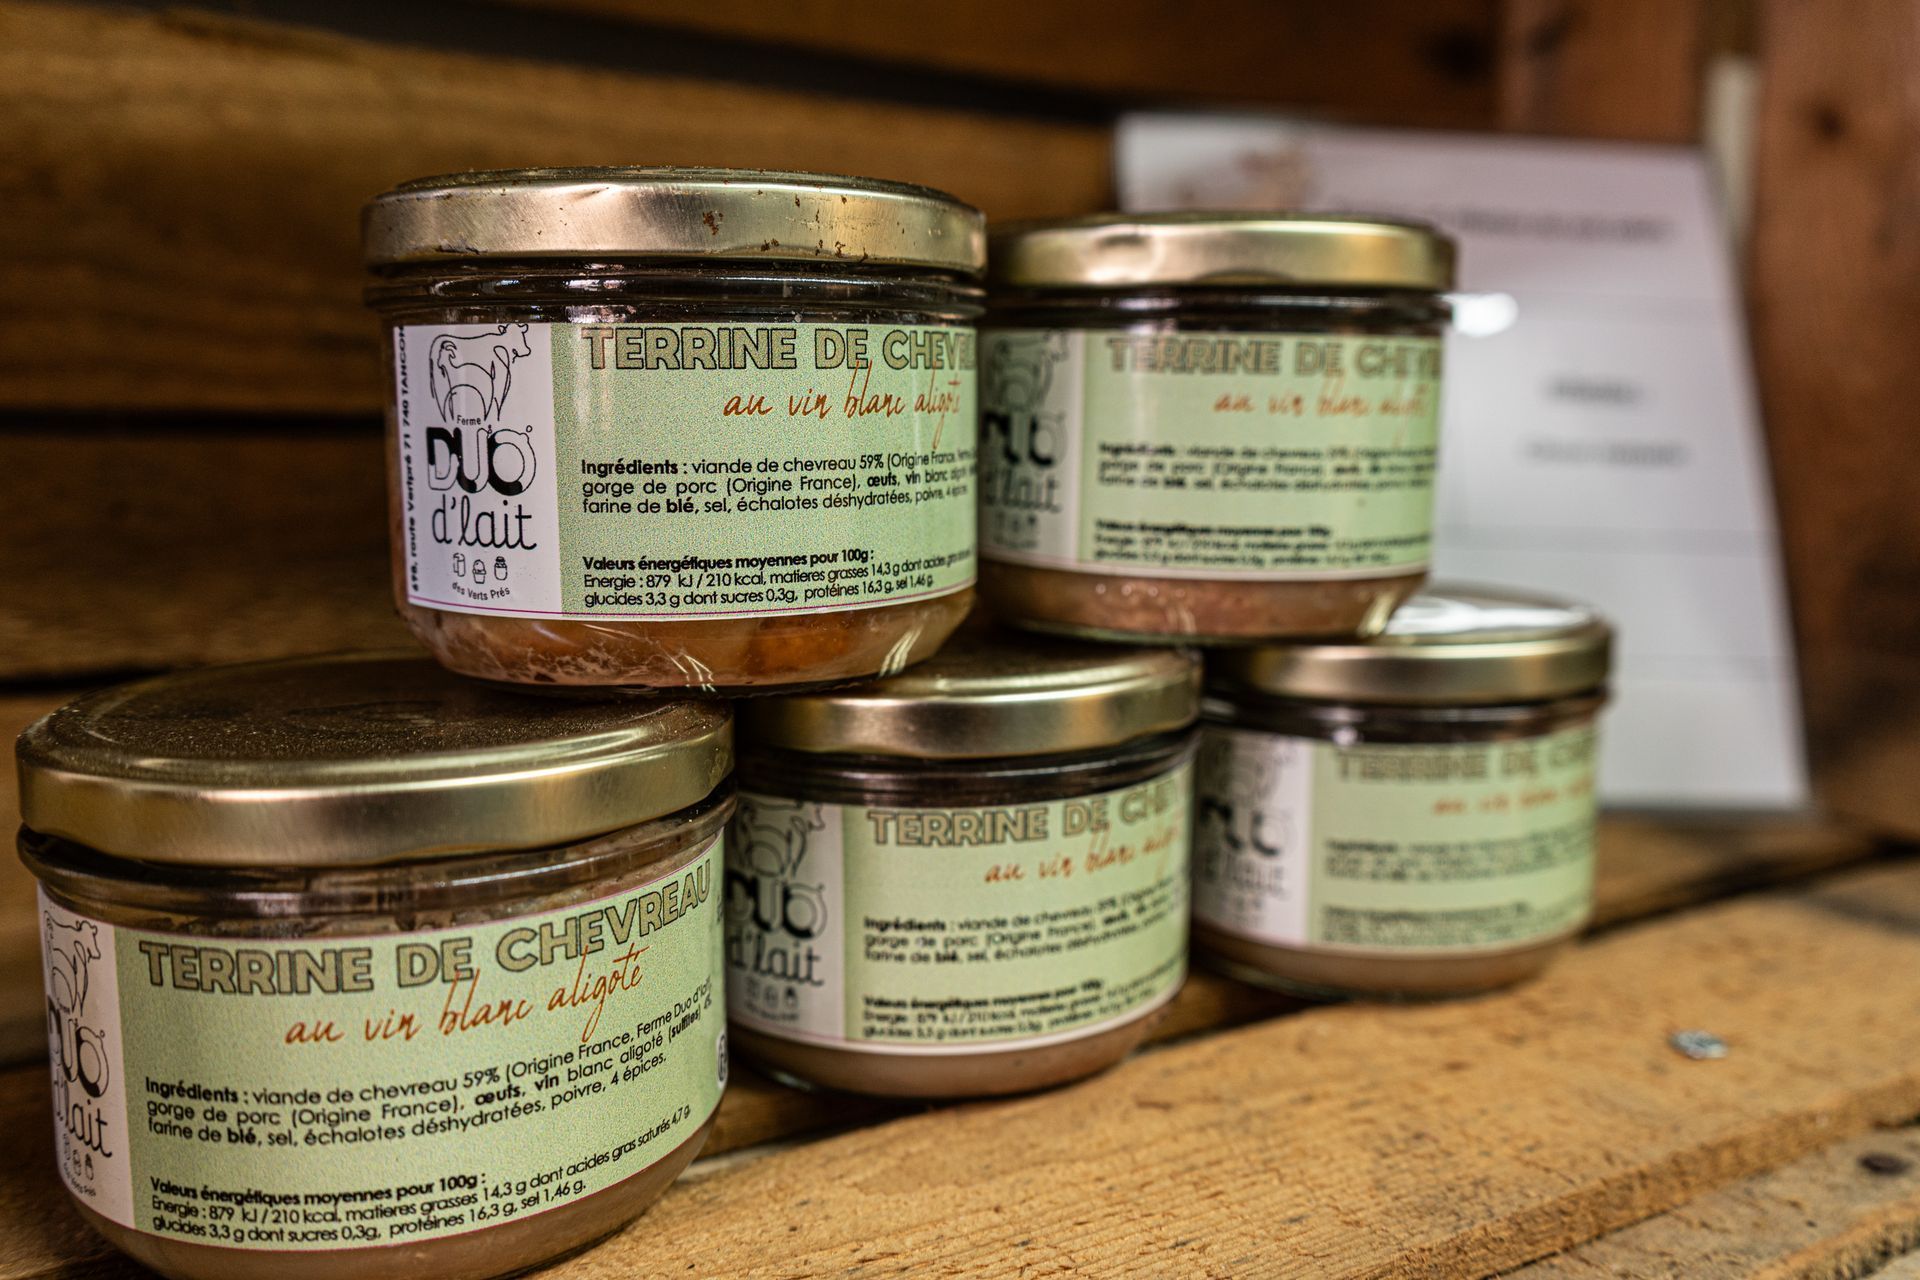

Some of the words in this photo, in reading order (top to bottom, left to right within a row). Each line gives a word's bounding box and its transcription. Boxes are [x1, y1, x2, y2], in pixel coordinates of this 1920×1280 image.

[580, 326, 797, 370] TERRINE
[815, 328, 869, 370] DE
[1106, 338, 1281, 376] TERRINE
[1296, 341, 1345, 378] DE
[722, 394, 772, 416] au
[788, 388, 832, 419] vin
[843, 358, 906, 419] blanc
[456, 414, 482, 426] Ferme
[426, 425, 536, 496] DUO
[581, 458, 678, 477] Ingrédients
[692, 458, 752, 474] viande
[756, 457, 779, 473] de
[783, 457, 856, 472] chevreau
[859, 454, 884, 469] 59%
[887, 453, 929, 470] (Origine
[582, 481, 634, 497] gorge
[643, 480, 667, 494] de
[676, 481, 717, 497] porc
[727, 477, 792, 497] (Origine
[800, 474, 861, 492] France),
[867, 472, 900, 488] œufs,
[905, 470, 921, 485] vin
[583, 499, 631, 514] farine
[637, 498, 660, 513] de
[666, 496, 699, 514] blé,
[704, 498, 731, 514] sel,
[737, 495, 818, 512] échalotes
[823, 491, 913, 510] déshydratées,
[432, 494, 537, 550] d'lait
[582, 556, 635, 571] Valeurs
[638, 555, 732, 573] énergétiques
[735, 554, 807, 571] moyennes
[810, 552, 839, 568] pour
[584, 574, 636, 591] Energie
[646, 574, 671, 588] 879
[678, 573, 693, 588] kJ
[706, 573, 731, 587] 210
[734, 572, 766, 586] kcal,
[770, 568, 825, 585] matieres
[827, 567, 868, 584] grasses
[871, 563, 891, 576] 14,3
[892, 563, 900, 572] g
[901, 558, 922, 573] dont
[467, 588, 488, 601] Verts
[490, 586, 511, 600] Prés
[585, 592, 642, 608] glucides
[645, 592, 667, 606] 3,3
[669, 594, 680, 607] g
[683, 591, 718, 605] dont
[720, 591, 764, 604] sucres
[804, 583, 859, 602] protéines
[862, 581, 883, 594] 16,3
[896, 576, 908, 589] sel
[867, 806, 1049, 847] TERRINE
[1062, 799, 1111, 838] DE
[984, 863, 1025, 883] au
[1038, 853, 1075, 879] vin
[139, 940, 374, 995] TERRINE
[396, 937, 474, 988] DE
[496, 859, 711, 973] CHEVREAU
[285, 1020, 345, 1044] au
[364, 1009, 424, 1042] vin
[438, 967, 535, 1036] blanc
[547, 943, 652, 1044] aligoté
[145, 1076, 238, 1102] Ingrédients
[253, 1088, 321, 1105] viande
[327, 1087, 354, 1103] de
[359, 1078, 457, 1102] chevreau
[462, 1067, 501, 1089] 59%
[505, 1049, 574, 1083] (Origine
[578, 1032, 635, 1059] France,
[637, 1012, 672, 1039] Ferme
[673, 996, 692, 1018] Duo
[147, 1100, 195, 1120] gorge
[203, 1106, 227, 1122] de
[237, 1109, 281, 1131] porc
[292, 1107, 371, 1128] (Origine
[382, 1095, 465, 1119] France),
[474, 1081, 527, 1106] œufs,
[534, 1073, 559, 1092] vin
[567, 1056, 613, 1083] blanc
[619, 1031, 664, 1065] aligoté
[148, 1119, 193, 1139] farine
[198, 1125, 222, 1143] de
[227, 1127, 262, 1147] blé,
[267, 1129, 298, 1147] sel,
[304, 1123, 406, 1146] échalotes
[412, 1099, 545, 1135] déshydratées,
[551, 1079, 606, 1108] poivre,
[610, 1072, 620, 1086] 4
[150, 1176, 198, 1198] Valeurs
[201, 1185, 301, 1207] énergétiques
[304, 1187, 392, 1206] moyennes
[397, 1180, 434, 1201] pour
[152, 1195, 200, 1220] Energie
[209, 1206, 235, 1221] 879
[241, 1207, 257, 1223] kJ
[272, 1208, 299, 1223] 210
[345, 1203, 417, 1222] matieres
[420, 1193, 478, 1214] grasses
[484, 1182, 513, 1200] 14,3
[516, 1180, 527, 1196] g
[530, 1168, 564, 1189] dont
[566, 1151, 611, 1177] acides
[611, 1140, 637, 1162] gras
[637, 1117, 671, 1149] saturés
[153, 1214, 206, 1239] glucides
[209, 1224, 231, 1240] 3,3
[233, 1228, 245, 1242] g
[247, 1227, 284, 1242] dont
[288, 1227, 338, 1242] sucres
[389, 1211, 464, 1239] protéines
[469, 1204, 500, 1223] 16,3
[502, 1201, 519, 1217] g,
[520, 1192, 540, 1210] sel
[543, 1185, 570, 1203] 1,46
